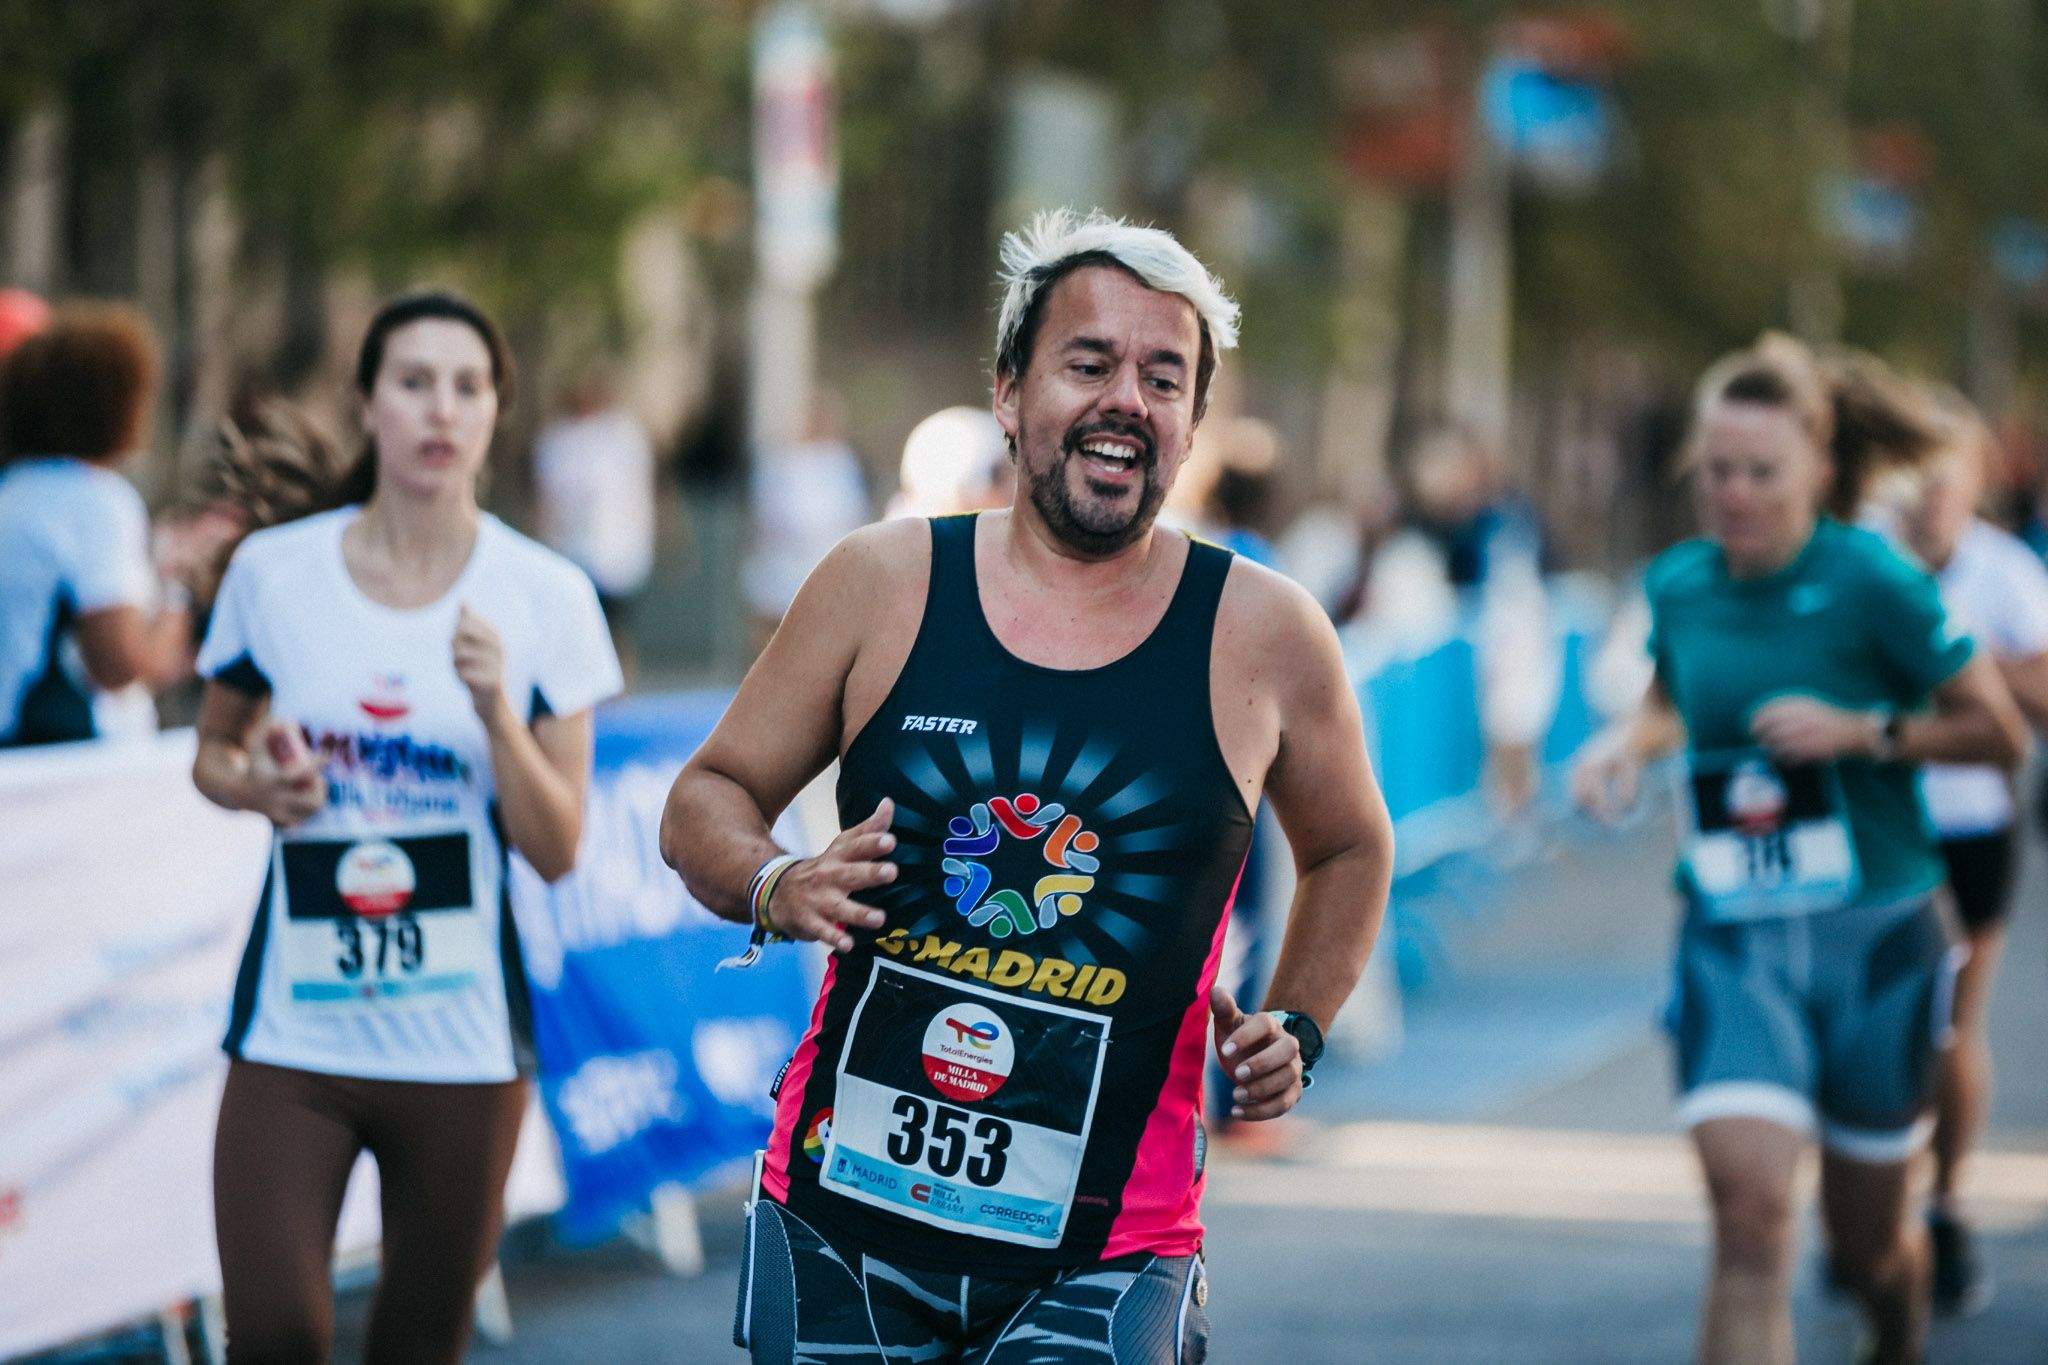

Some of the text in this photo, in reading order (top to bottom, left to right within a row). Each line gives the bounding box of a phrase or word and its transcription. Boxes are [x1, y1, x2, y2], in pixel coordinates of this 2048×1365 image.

[902, 715, 978, 735] FASTER
[337, 917, 423, 979] 379
[940, 1044, 994, 1065] TotalEnergies
[933, 1071, 988, 1094] DE MADRID
[947, 1064, 978, 1081] MILLA
[887, 1094, 1013, 1188] 353
[852, 1164, 898, 1190] MADRID
